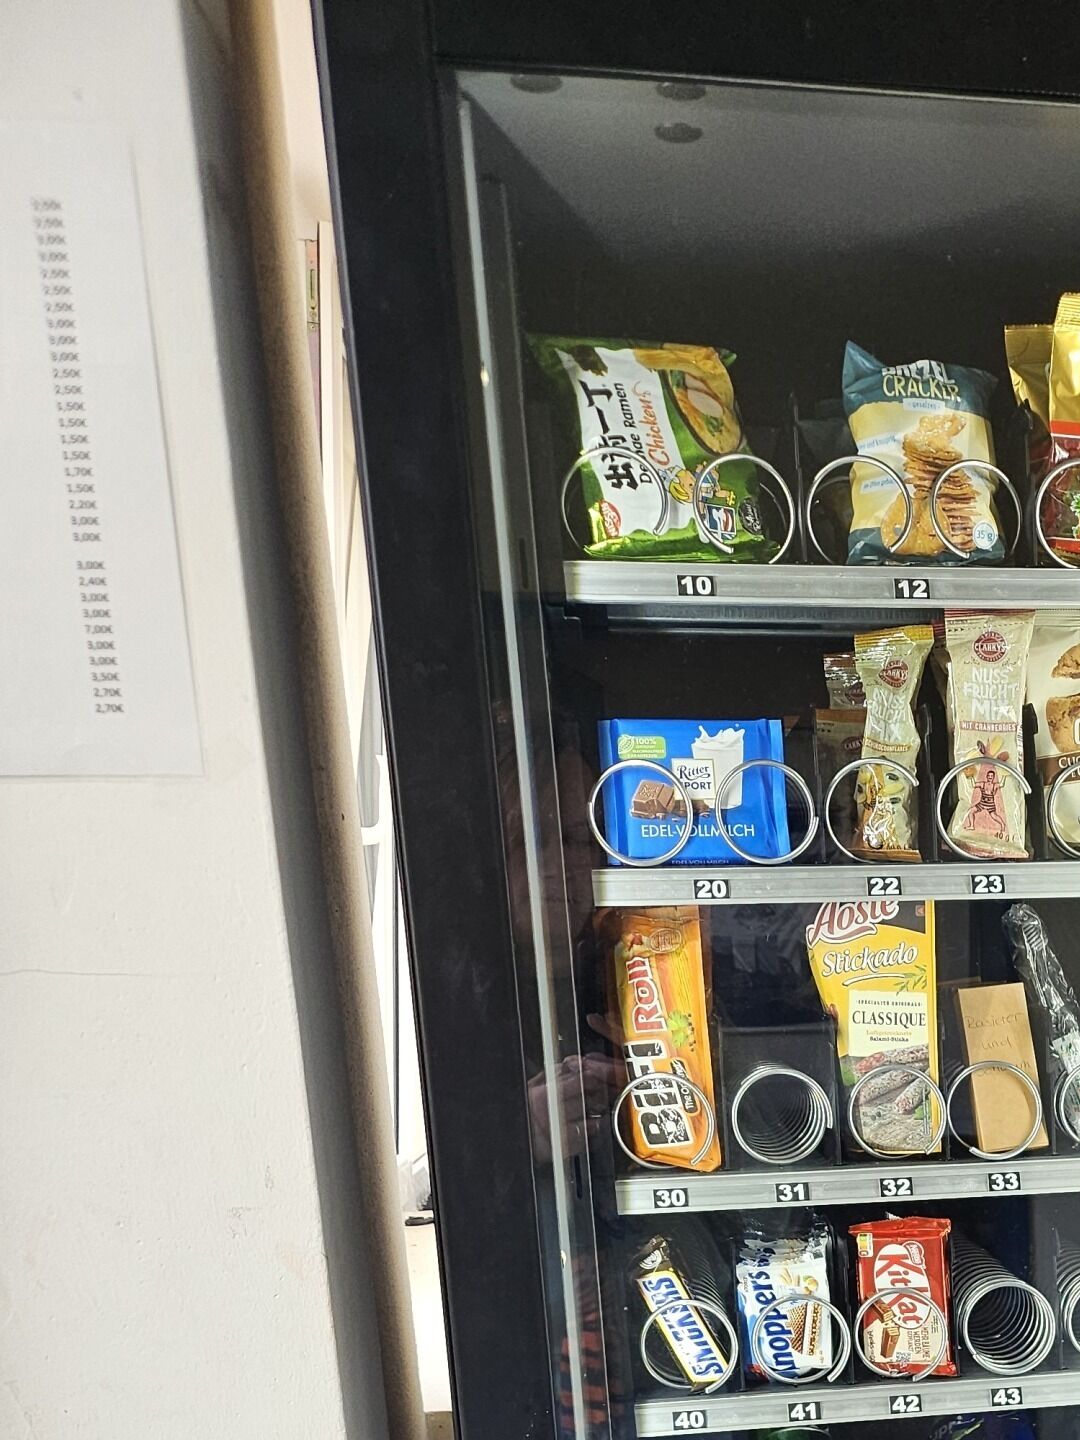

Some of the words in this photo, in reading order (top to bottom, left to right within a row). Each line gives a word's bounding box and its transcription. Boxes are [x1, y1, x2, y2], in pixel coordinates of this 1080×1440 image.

[882, 374, 961, 402] CRACKER
[613, 382, 638, 429] Ramen
[638, 397, 671, 467] Chicken
[976, 530, 986, 540] 35
[987, 531, 993, 541] g
[680, 576, 712, 595] 10
[897, 580, 929, 598] 12
[971, 666, 1009, 684] NUSS
[962, 683, 1020, 699] FRUCHT
[971, 699, 1017, 721] MIX
[962, 721, 972, 730] MIT
[975, 722, 1018, 732] CRANBERRIES
[634, 737, 657, 746] 100%
[676, 764, 711, 781] Ritter
[682, 782, 712, 790] PORT
[695, 881, 727, 899] 20
[869, 878, 901, 894] 22
[974, 876, 1003, 893] 23
[821, 942, 919, 977] Stickado
[626, 956, 667, 1033] Roll
[851, 1010, 927, 1029] CLASSIQUE
[981, 1035, 1013, 1050] und
[882, 1178, 911, 1196] 32
[991, 1173, 1019, 1190] 33
[655, 1190, 687, 1207] 30
[778, 1184, 805, 1201] 31
[891, 1395, 921, 1412] 42
[993, 1388, 1021, 1405] 43
[674, 1411, 704, 1429] 40
[790, 1403, 818, 1420] 41
